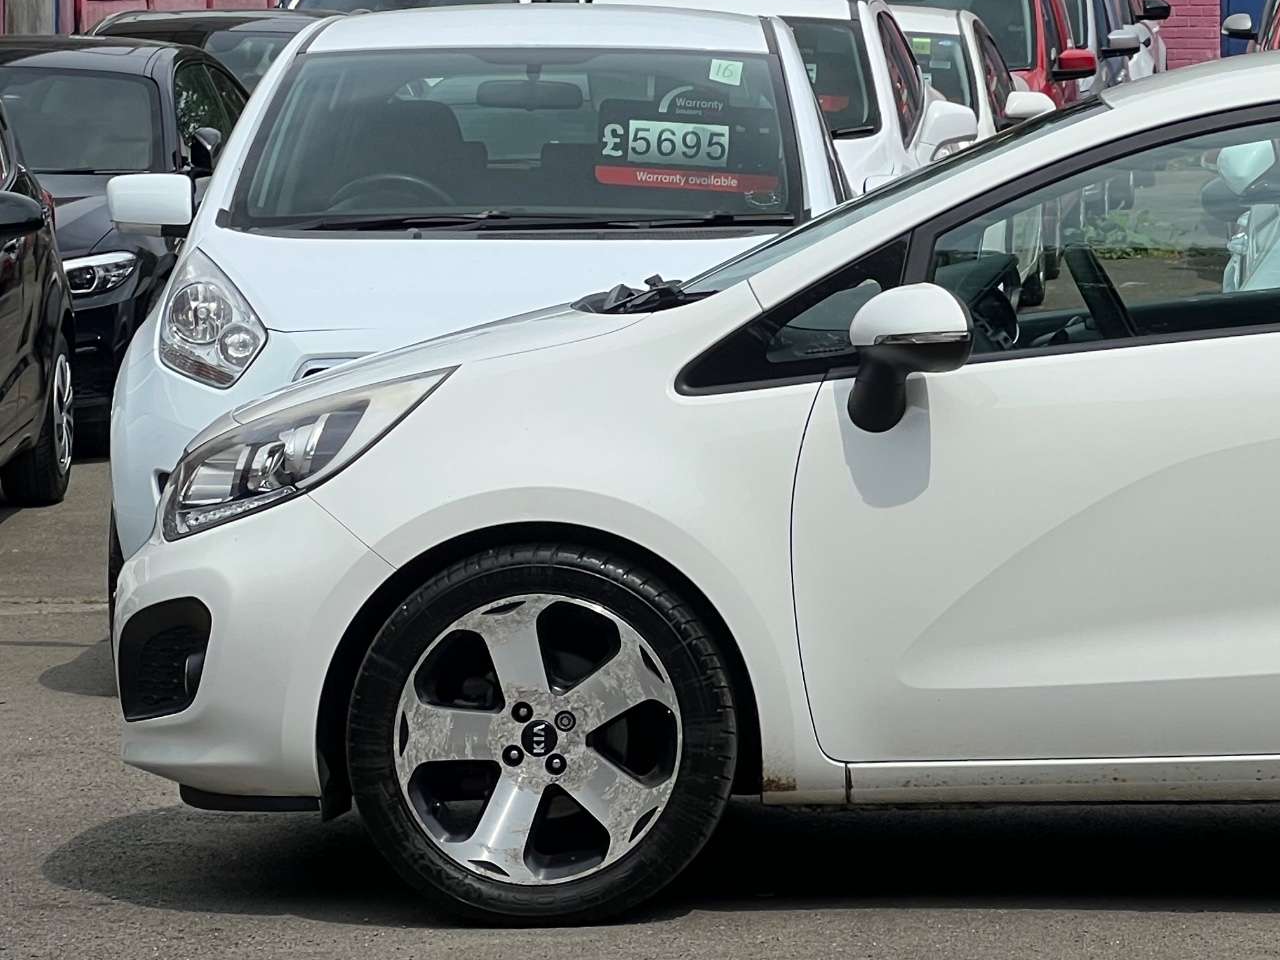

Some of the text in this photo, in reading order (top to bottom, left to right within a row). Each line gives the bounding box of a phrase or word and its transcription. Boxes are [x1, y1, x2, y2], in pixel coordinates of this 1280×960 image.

[716, 63, 734, 78] 16
[675, 97, 725, 113] Warranty
[601, 123, 727, 161] £5695
[636, 171, 738, 187] Warranty available
[533, 723, 546, 754] KIA
